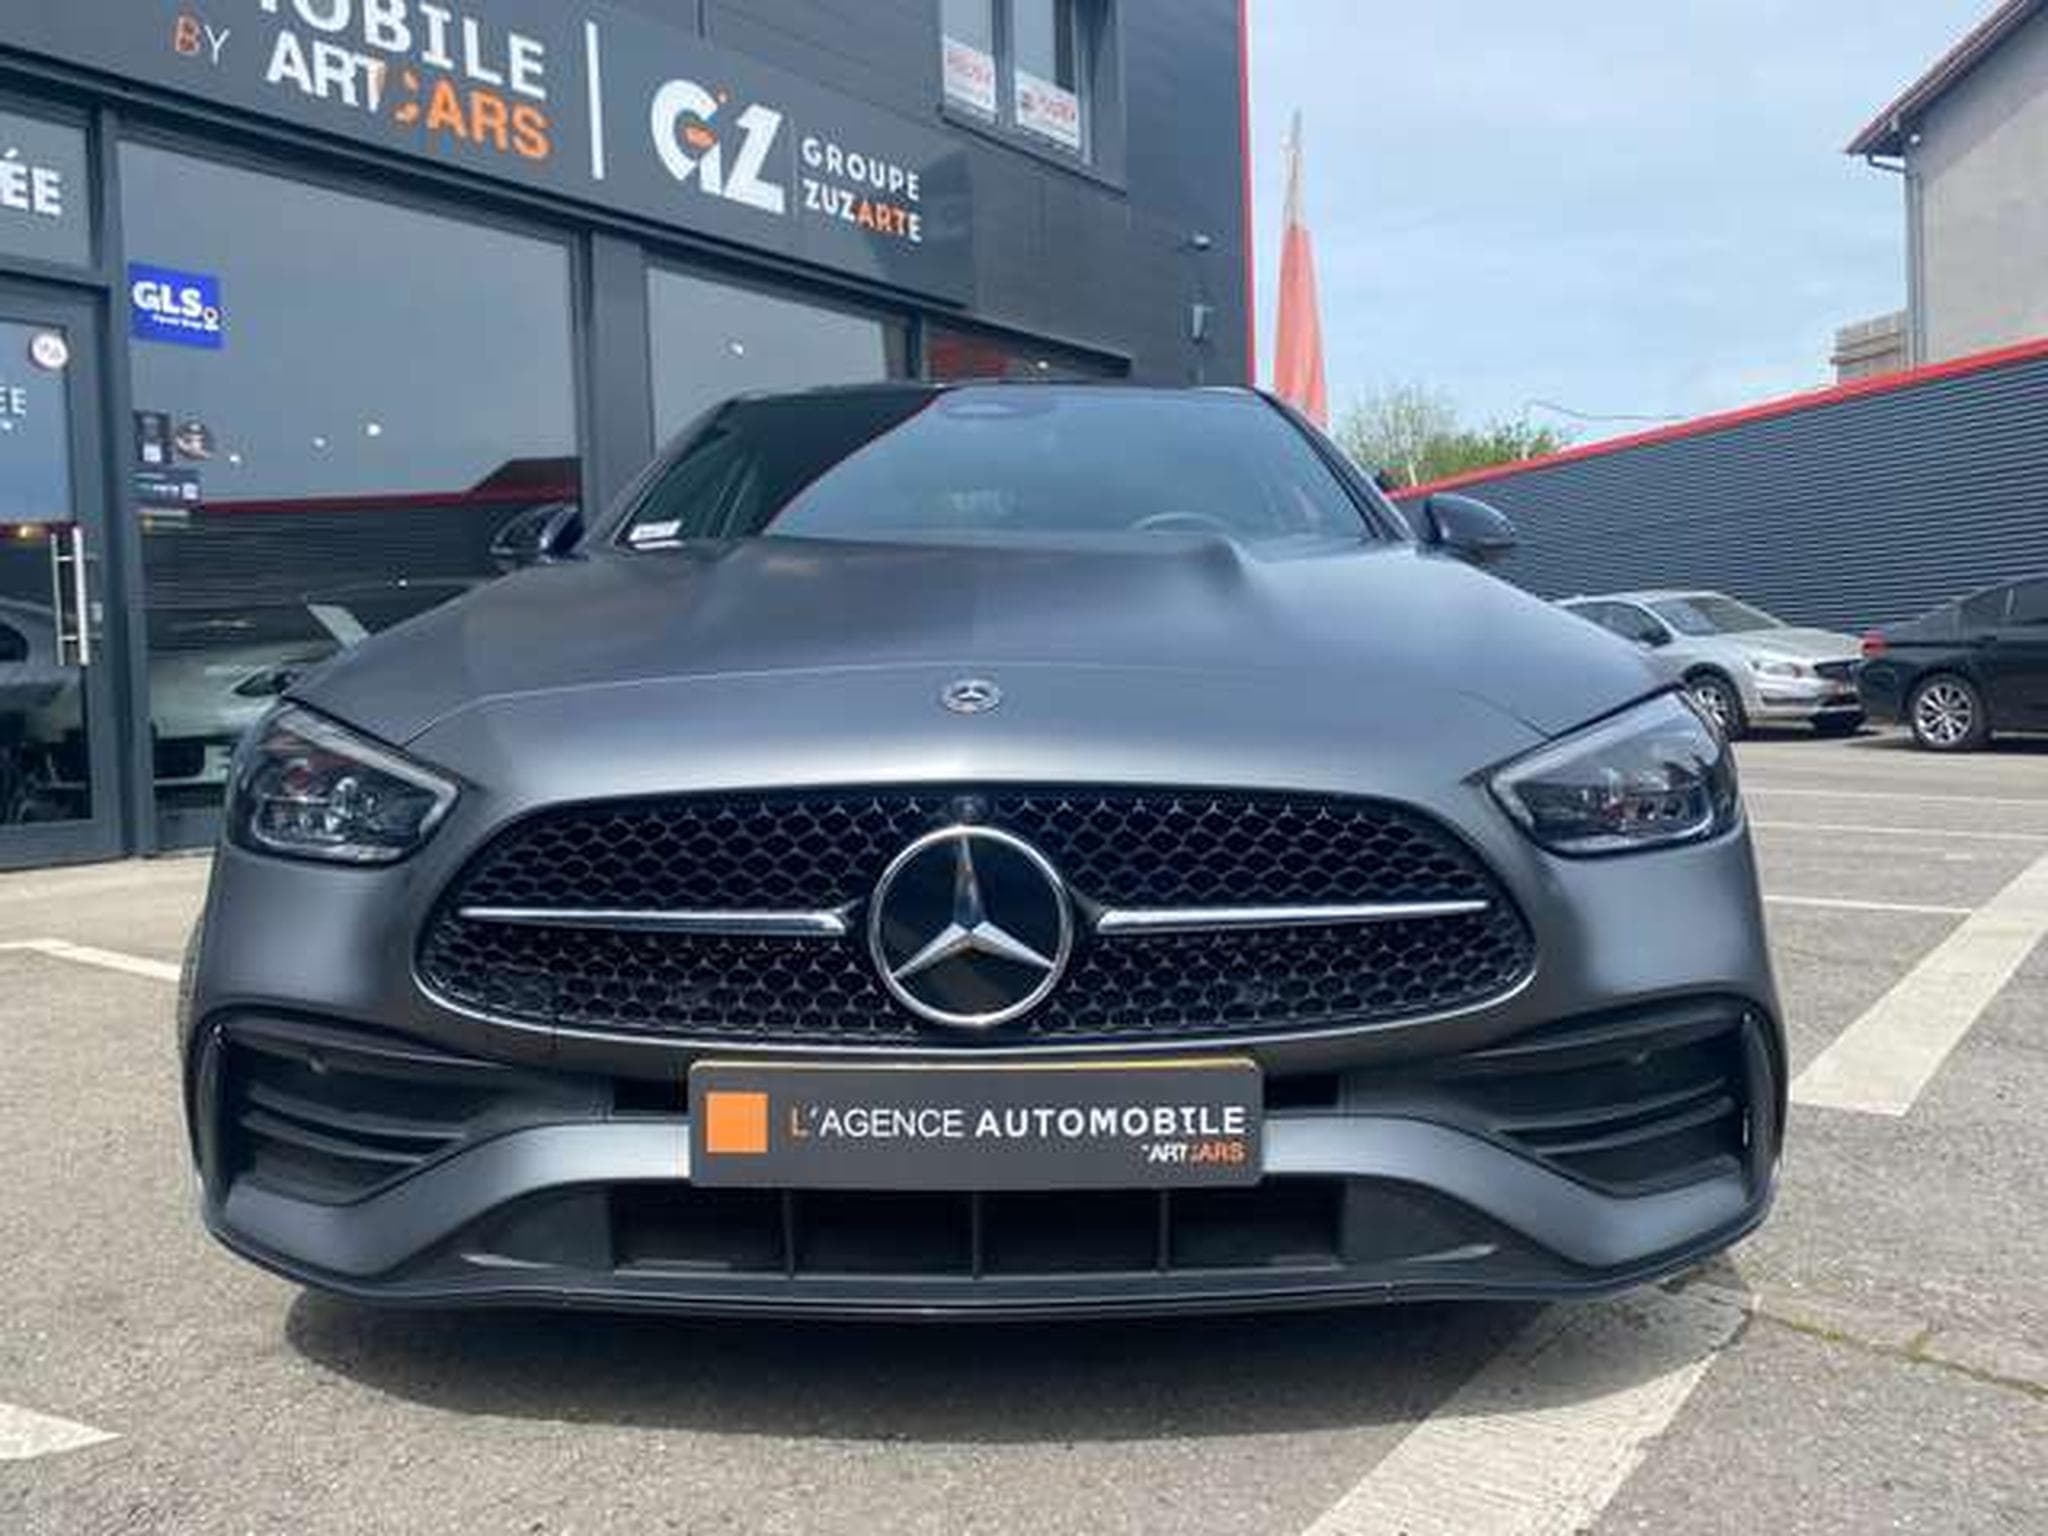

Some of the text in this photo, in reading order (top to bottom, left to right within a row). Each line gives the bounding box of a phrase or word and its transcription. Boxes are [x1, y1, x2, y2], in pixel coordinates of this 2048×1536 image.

[175, 16, 230, 64] BY
[261, 0, 547, 100] OBILE
[802, 137, 919, 201] GROUPE
[802, 179, 922, 242] ZUZARTE
[133, 281, 202, 317] GLS
[792, 1106, 1245, 1137] L'AGENCE AUTOMOBILE
